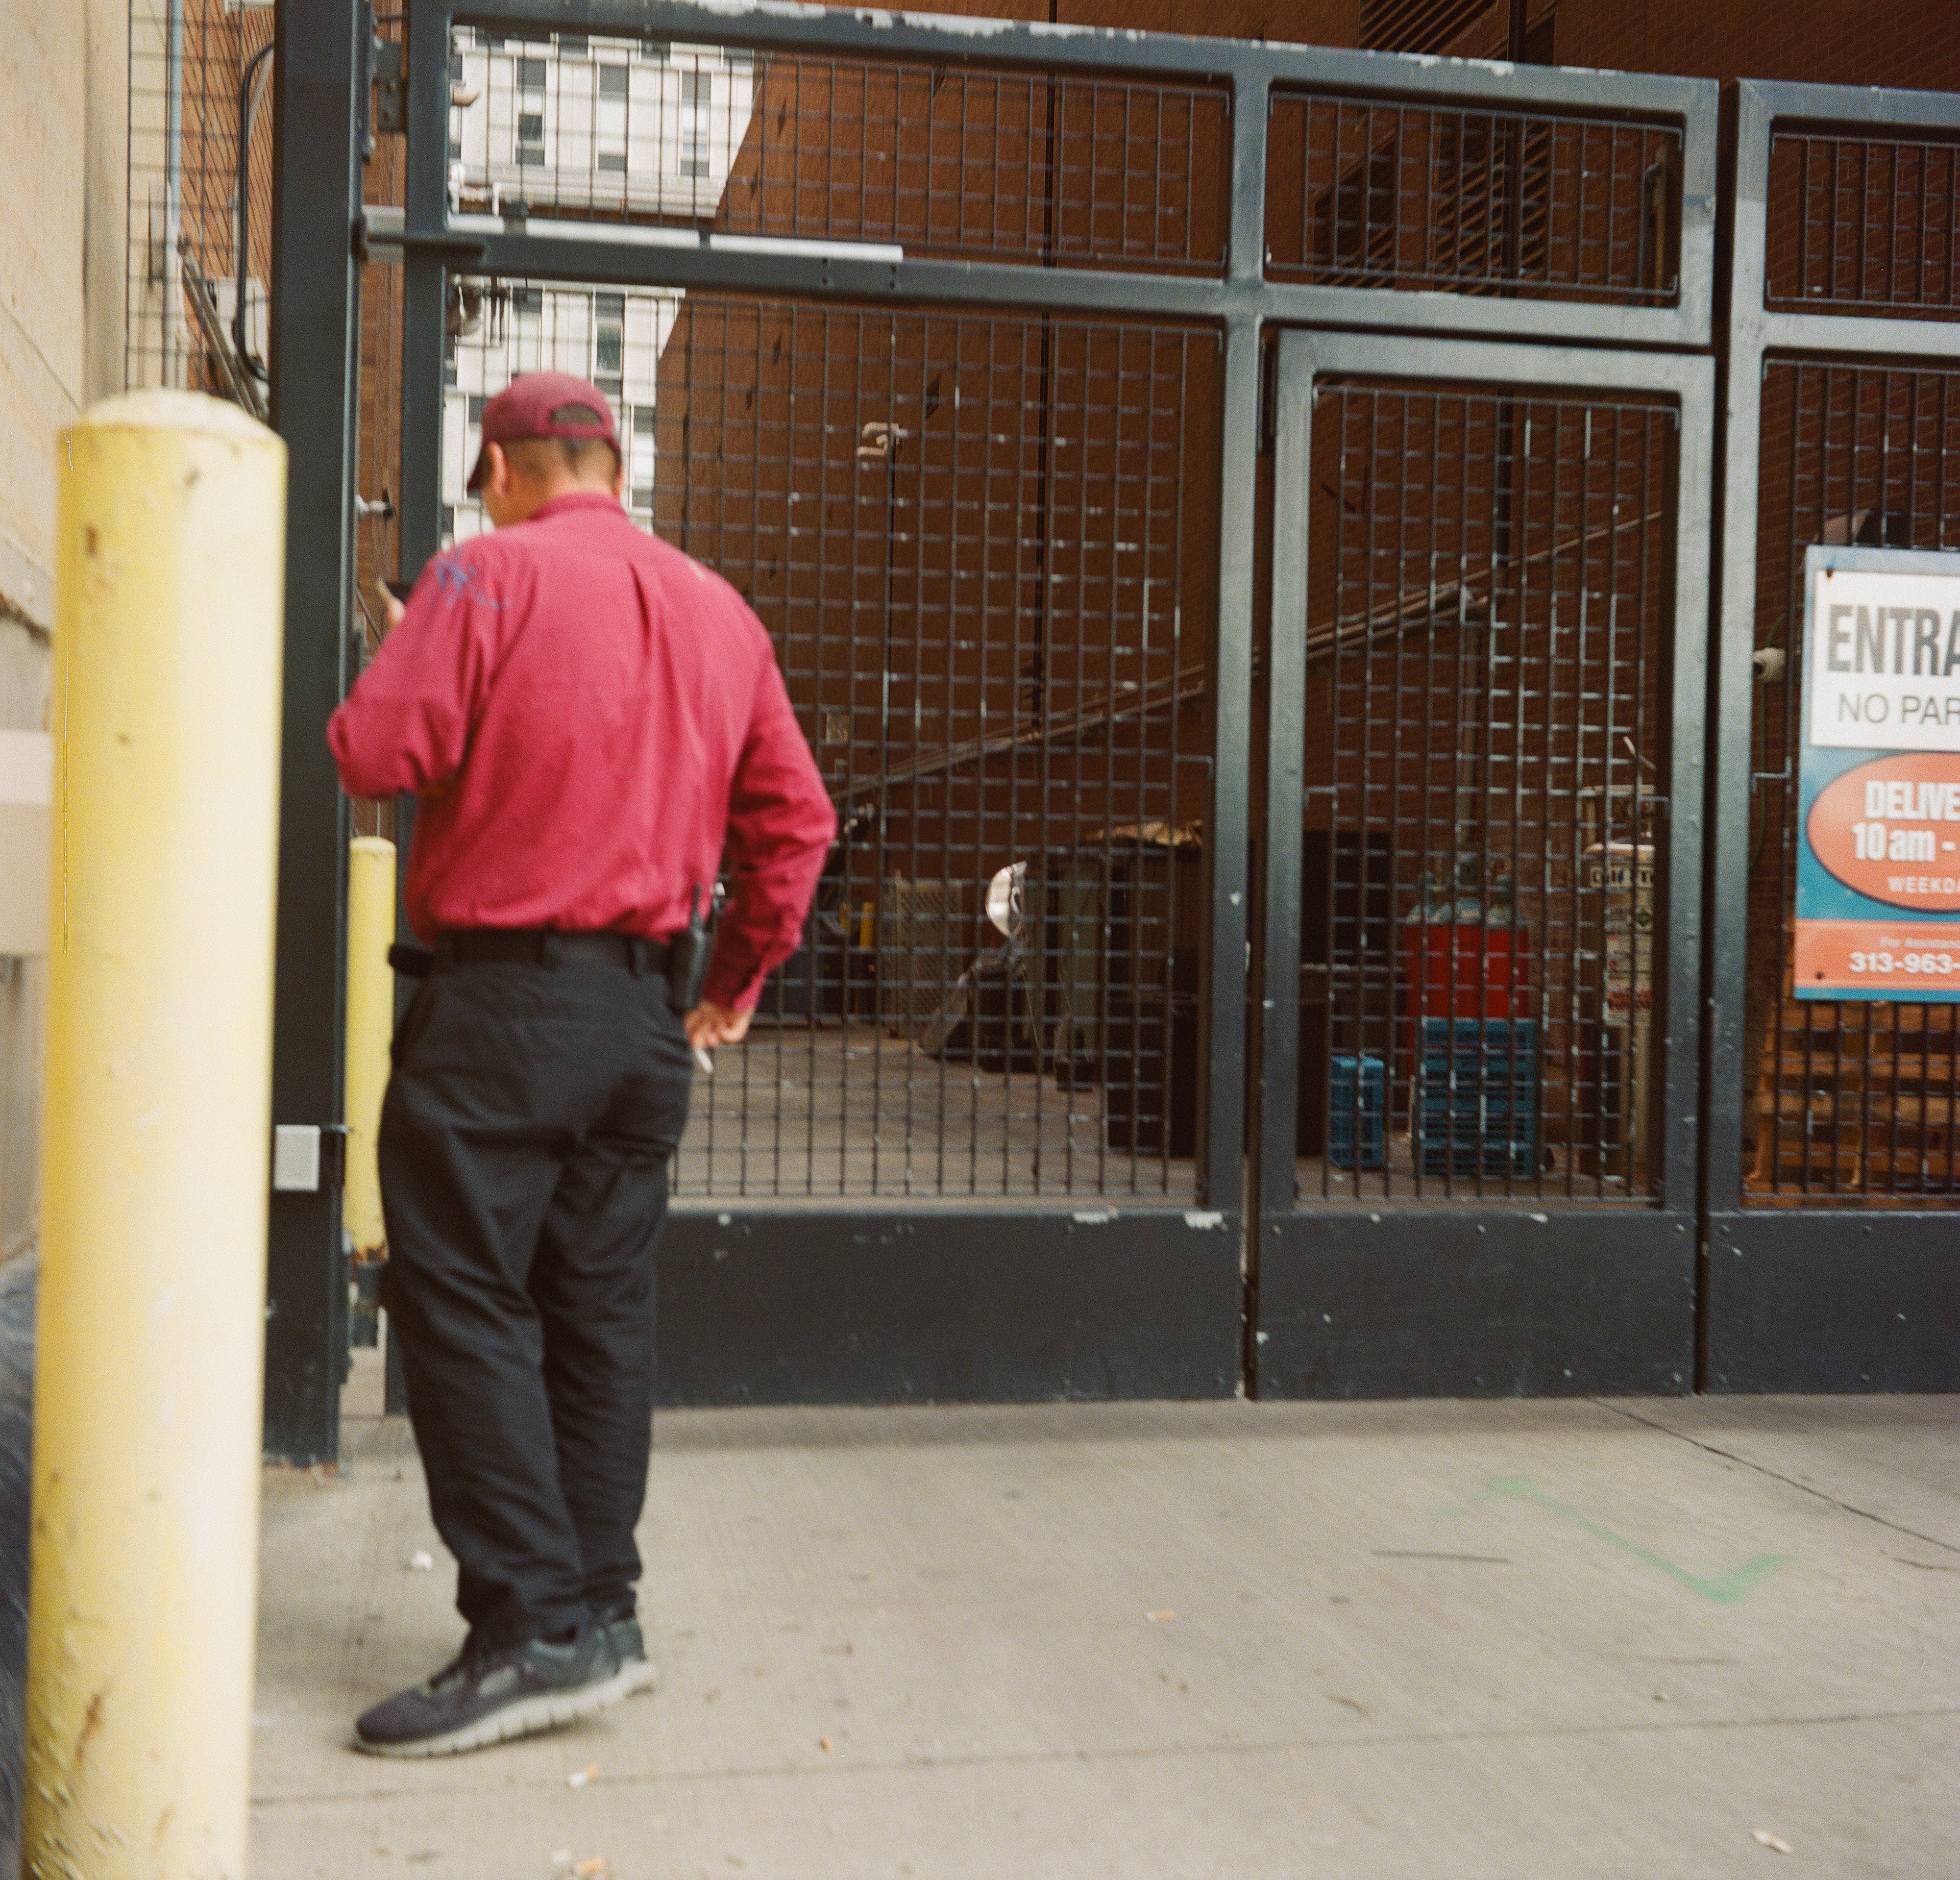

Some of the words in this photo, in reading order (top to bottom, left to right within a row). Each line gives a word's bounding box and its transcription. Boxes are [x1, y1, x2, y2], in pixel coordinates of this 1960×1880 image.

[1839, 694, 1889, 723] NO
[1902, 695, 1960, 725] PAR
[1866, 781, 1960, 820] DELIVE
